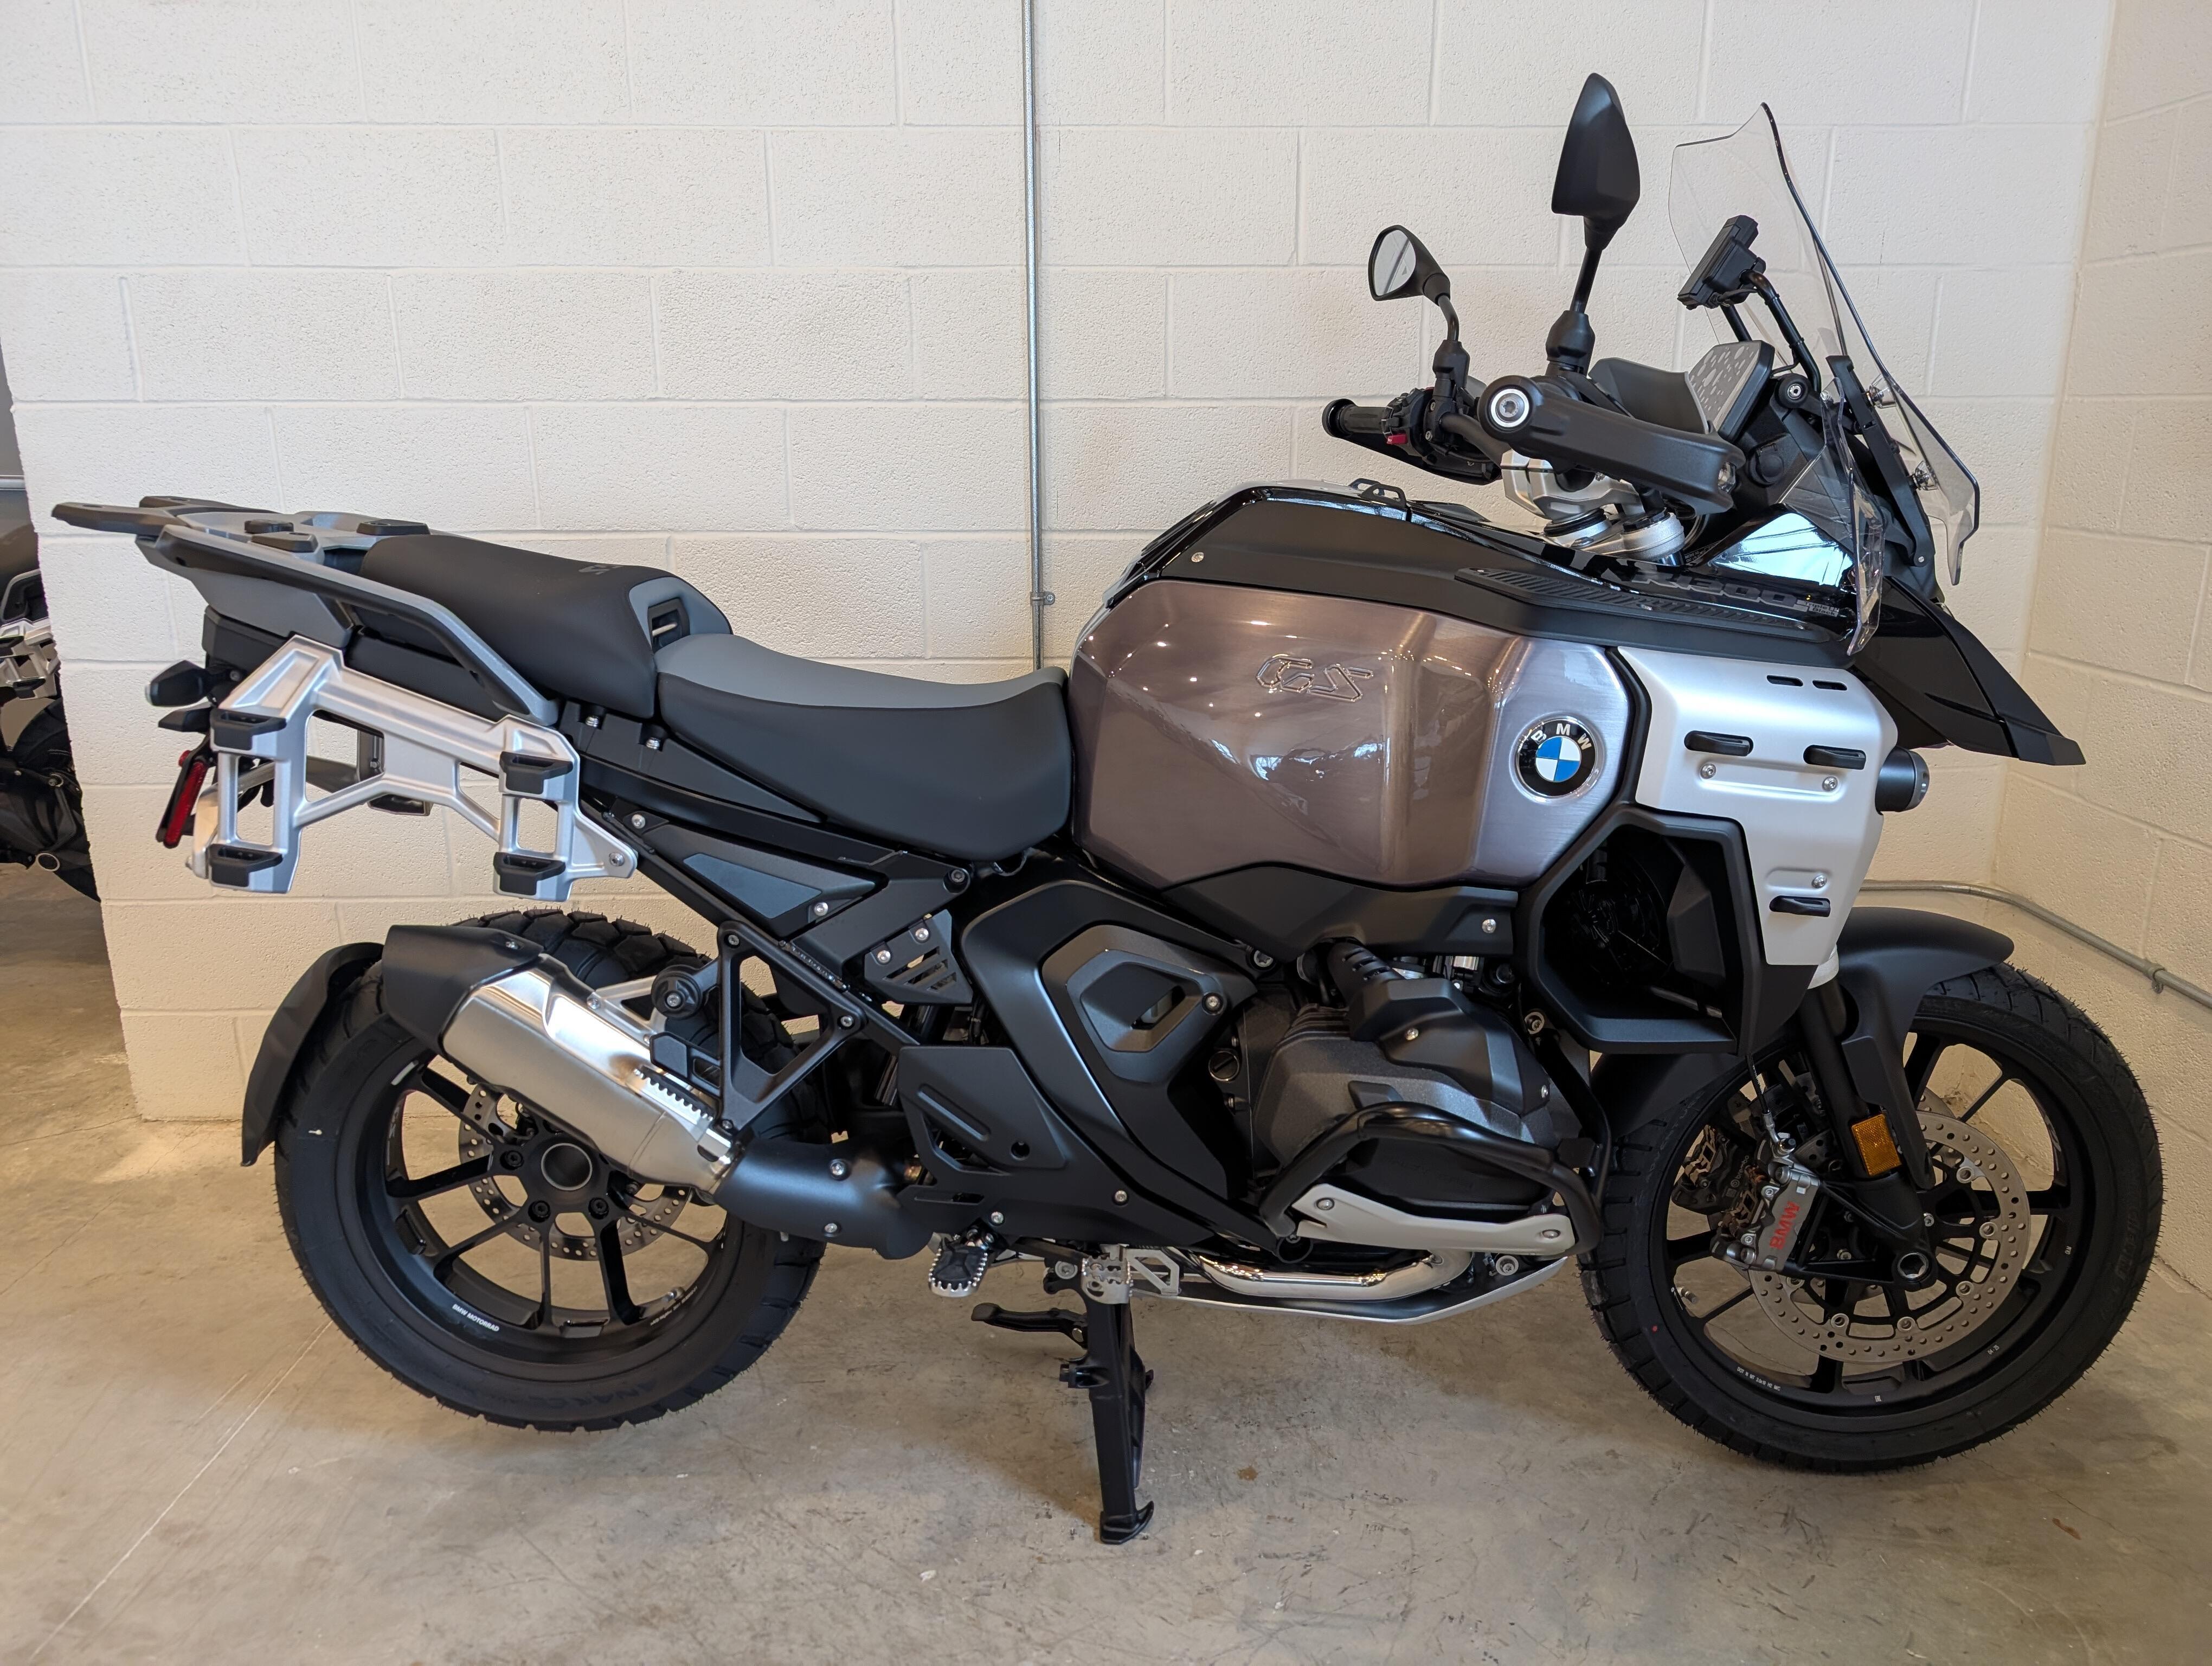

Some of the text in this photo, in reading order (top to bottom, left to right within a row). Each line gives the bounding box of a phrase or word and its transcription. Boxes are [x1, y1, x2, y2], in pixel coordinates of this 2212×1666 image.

[1256, 655, 1374, 703] GS
[1531, 723, 1592, 751] BMW
[1770, 1201, 1800, 1250] BMW
[452, 1304, 499, 1332] BMW MOTORRAD
